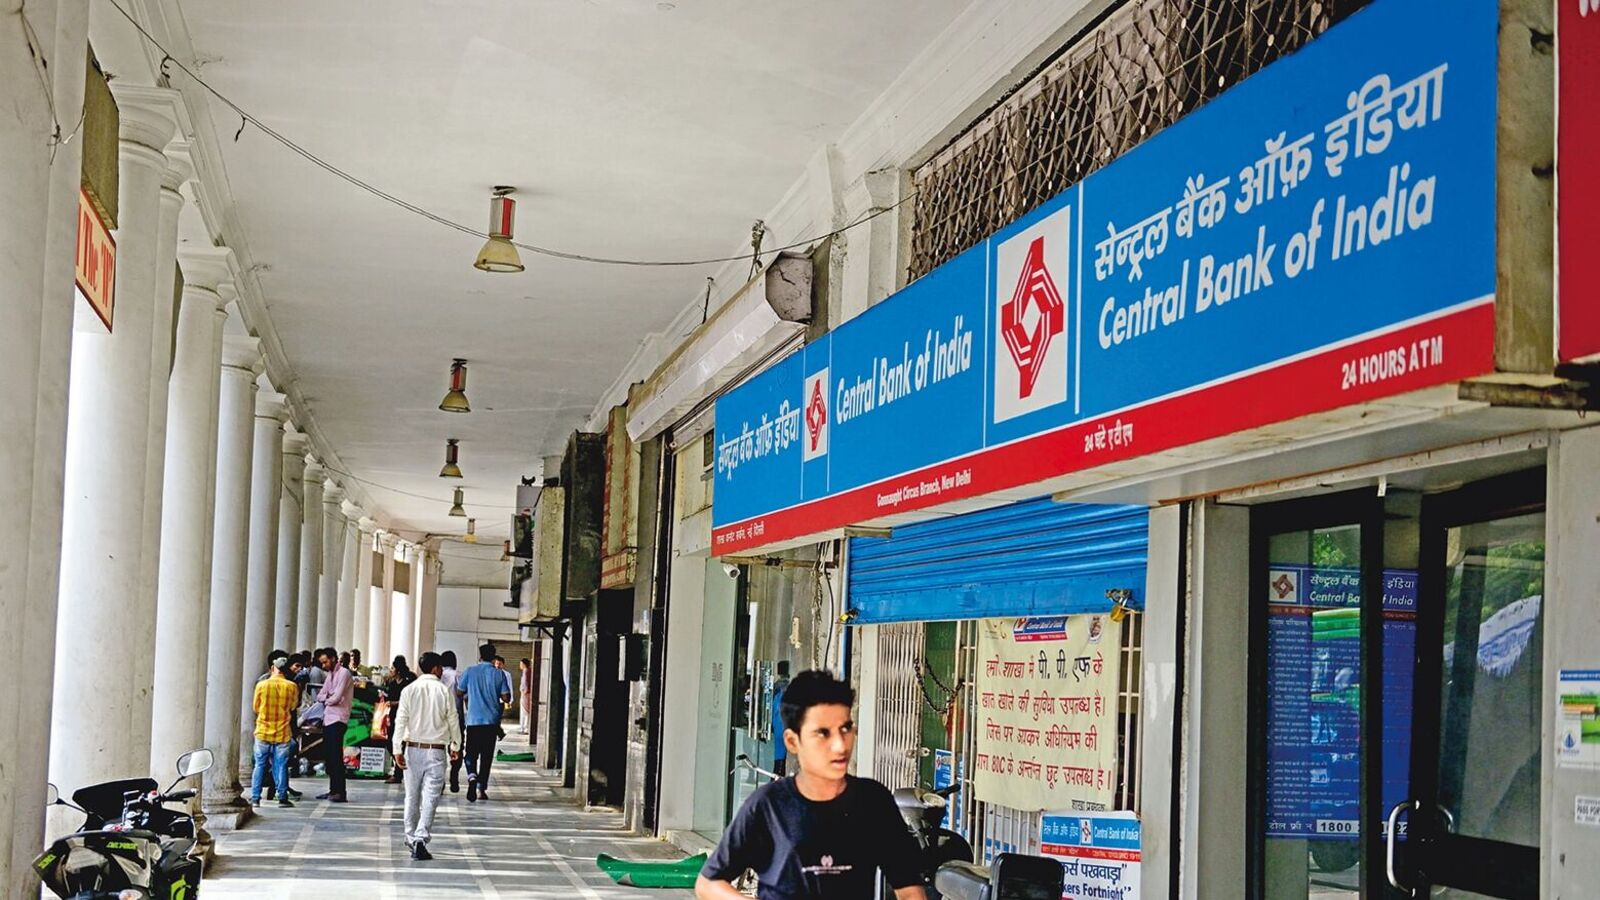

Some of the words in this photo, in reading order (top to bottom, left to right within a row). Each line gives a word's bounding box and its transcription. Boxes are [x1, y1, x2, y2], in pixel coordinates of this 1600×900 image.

[1095, 221, 1172, 283] सेन्ट्रल
[1176, 173, 1230, 239] बैंक
[1325, 62, 1448, 178] इंडिया
[1099, 259, 1190, 350] Central
[1195, 225, 1277, 314] Bank
[1284, 198, 1325, 278] of
[1331, 162, 1436, 261] India
[836, 357, 877, 425] Central
[878, 341, 912, 406] Bank
[915, 329, 932, 391] of
[933, 314, 972, 384] India
[1341, 360, 1357, 390] 24
[1360, 346, 1406, 385] HOURS
[718, 433, 740, 480] सेन्ट्रल
[740, 421, 755, 463] बैंक
[775, 400, 801, 455] इंडिया
[903, 485, 919, 500] Circus
[942, 475, 955, 491] New
[956, 468, 972, 487] Delhi
[1387, 578, 1415, 590] इंडिया
[1309, 591, 1345, 603] Central
[1347, 593, 1360, 604] Ba
[1388, 595, 1414, 606] India
[1003, 662, 1025, 678] शाखा
[1072, 657, 1091, 682] एफ
[1018, 689, 1030, 712] की
[1003, 726, 1013, 743] पर
[1085, 724, 1098, 751] की
[1062, 766, 1094, 788] उपलब्ध
[1094, 826, 1108, 839] Central
[1109, 827, 1120, 840] Bank
[1121, 827, 1127, 839] of
[1127, 828, 1139, 840] India
[1320, 822, 1352, 833] 1800
